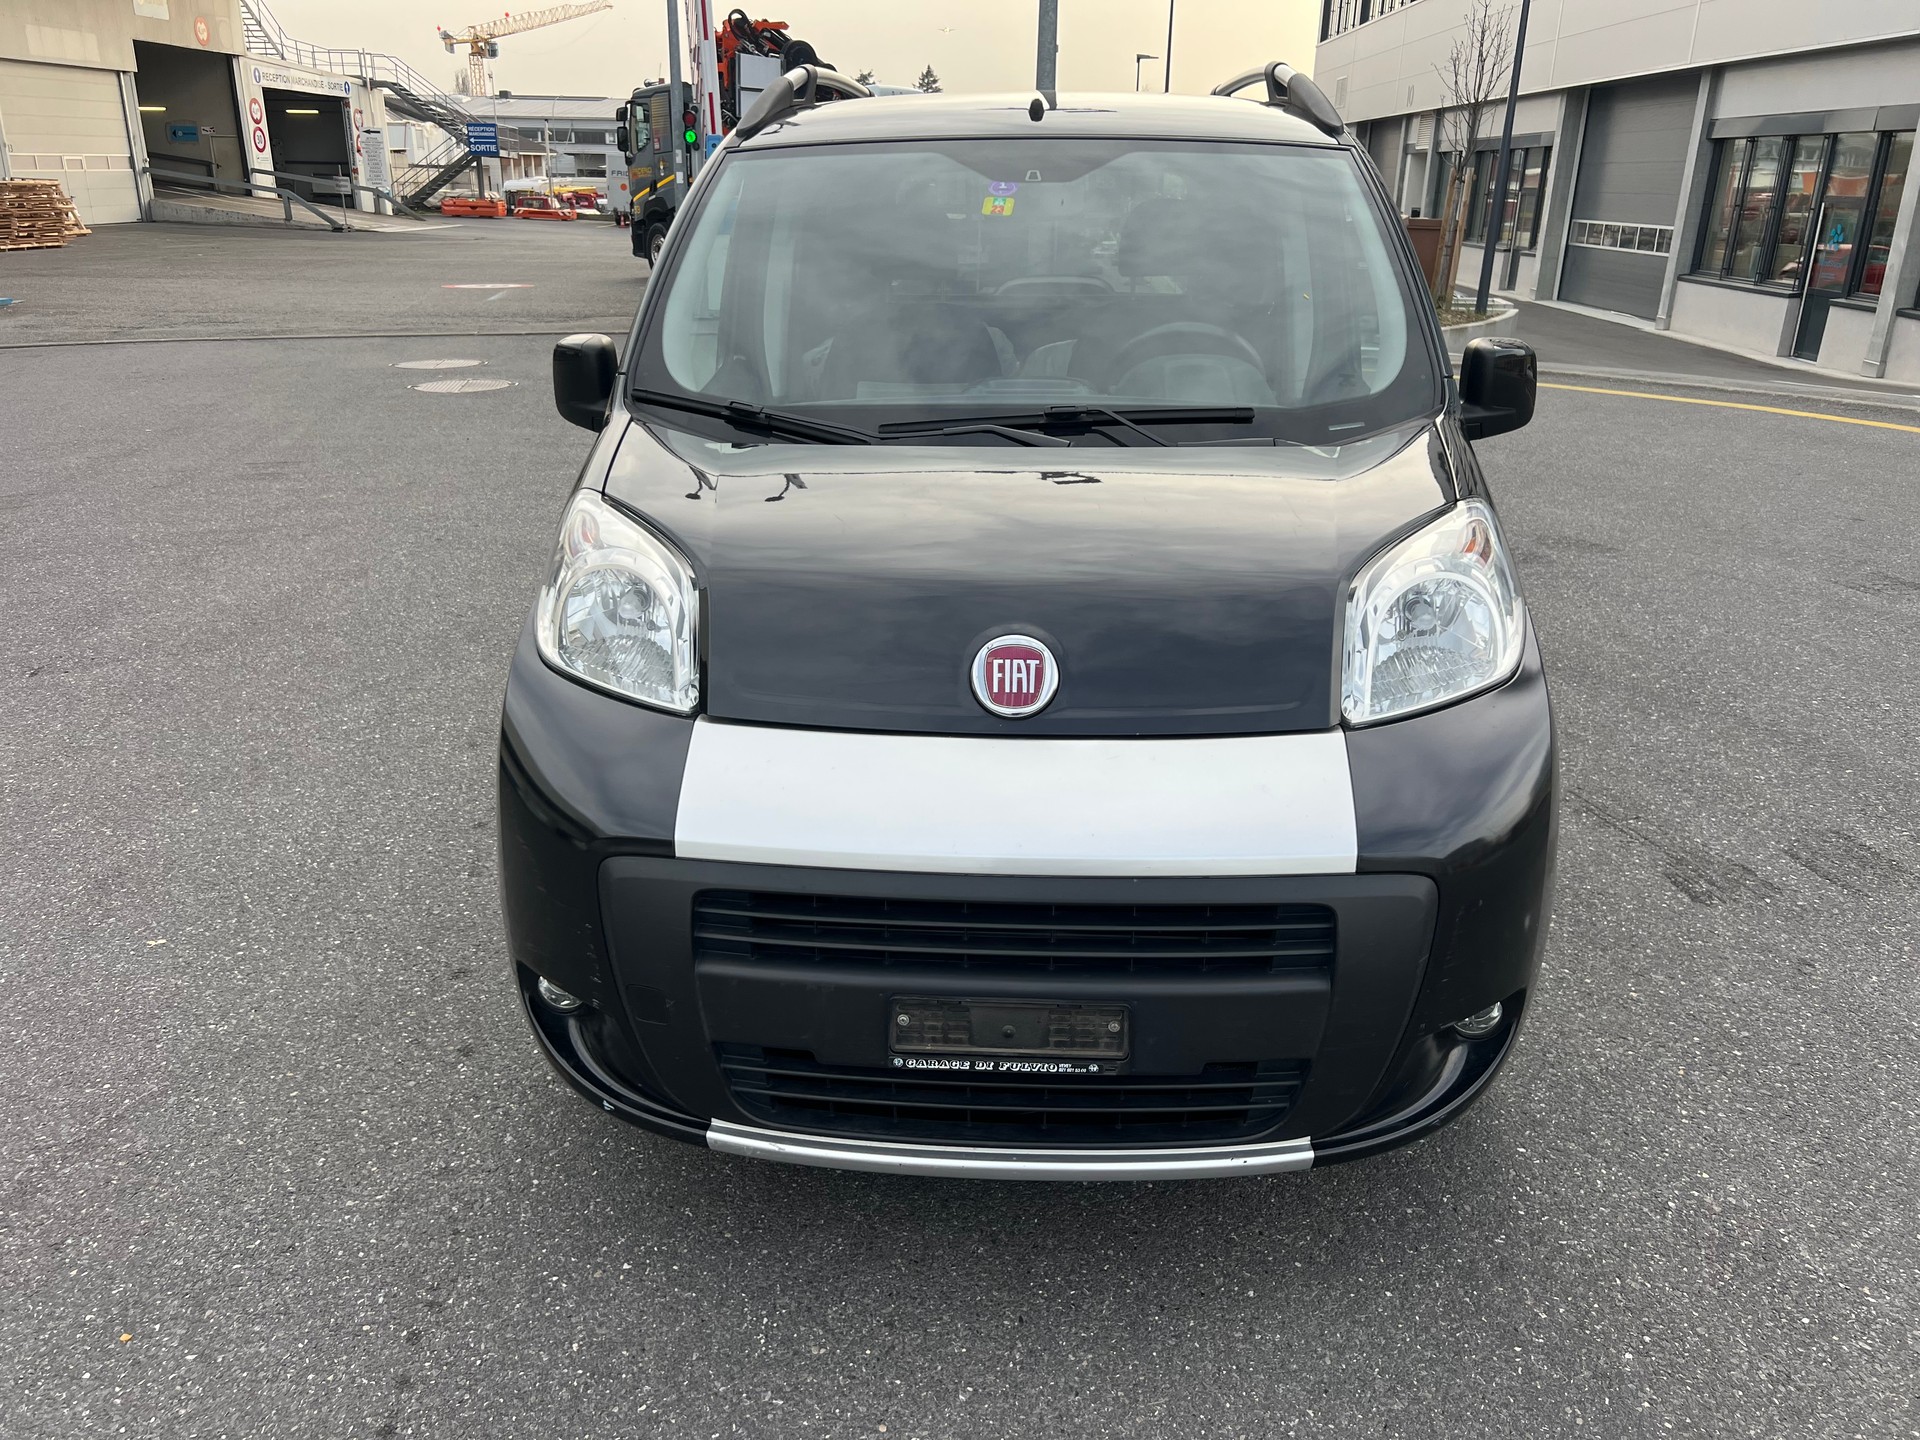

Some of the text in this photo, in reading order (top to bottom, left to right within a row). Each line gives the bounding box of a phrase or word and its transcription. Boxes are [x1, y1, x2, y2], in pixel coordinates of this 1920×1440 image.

[327, 82, 344, 92] SORTIE
[470, 144, 497, 152] SORTIE
[993, 659, 1040, 694] FIAT
[905, 1058, 1058, 1072] GARAGE DI FULVIO
